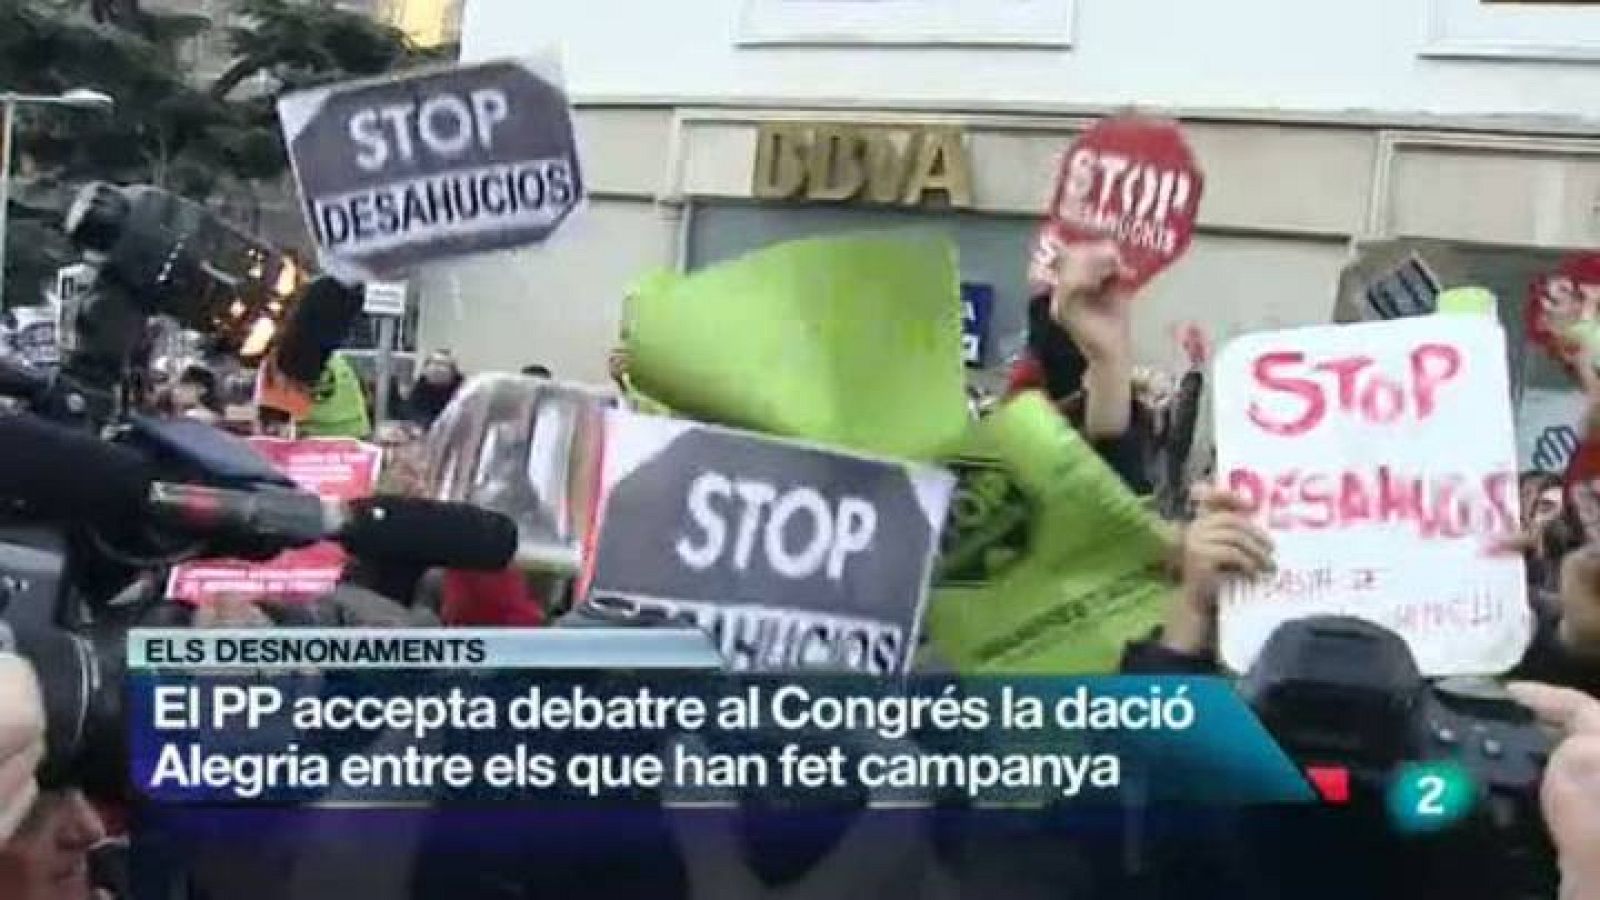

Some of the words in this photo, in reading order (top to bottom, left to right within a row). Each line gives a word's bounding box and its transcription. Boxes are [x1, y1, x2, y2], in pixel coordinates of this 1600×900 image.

[350, 88, 507, 171] STOP
[321, 163, 571, 248] DESAHUCIOS
[1060, 150, 1190, 222] STOP
[676, 473, 876, 579] STOP
